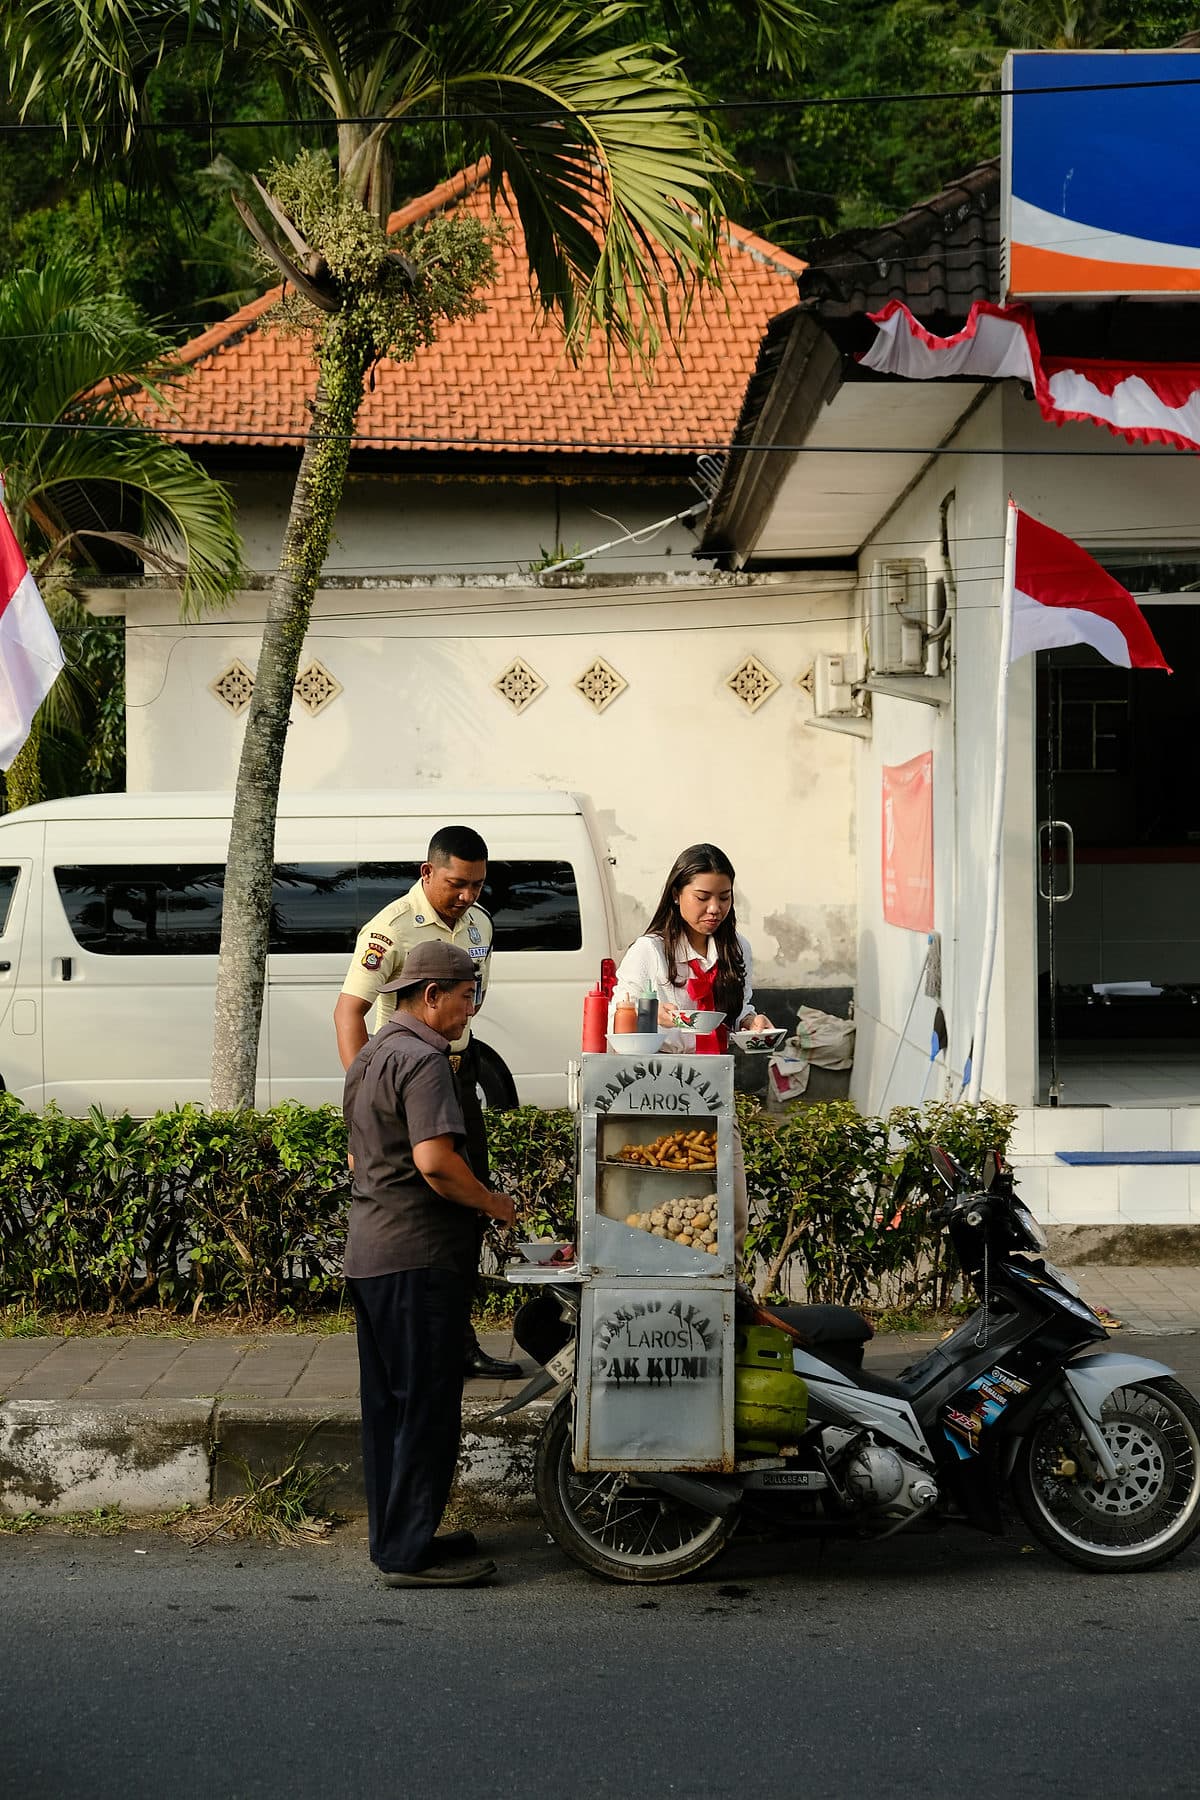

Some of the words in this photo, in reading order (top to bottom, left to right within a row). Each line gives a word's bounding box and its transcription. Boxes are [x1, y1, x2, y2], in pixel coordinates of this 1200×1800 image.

[372, 933, 391, 945] POLDA
[594, 1060, 662, 1113] BAKSO
[669, 1062, 724, 1112] AYAM
[629, 1092, 690, 1112] LAROS
[628, 1330, 688, 1349] LAROS
[551, 1360, 568, 1377] 28
[646, 1356, 721, 1379] KUMI
[998, 1373, 1022, 1394] YAMAHA
[763, 1474, 808, 1485] PULL&BEAR
